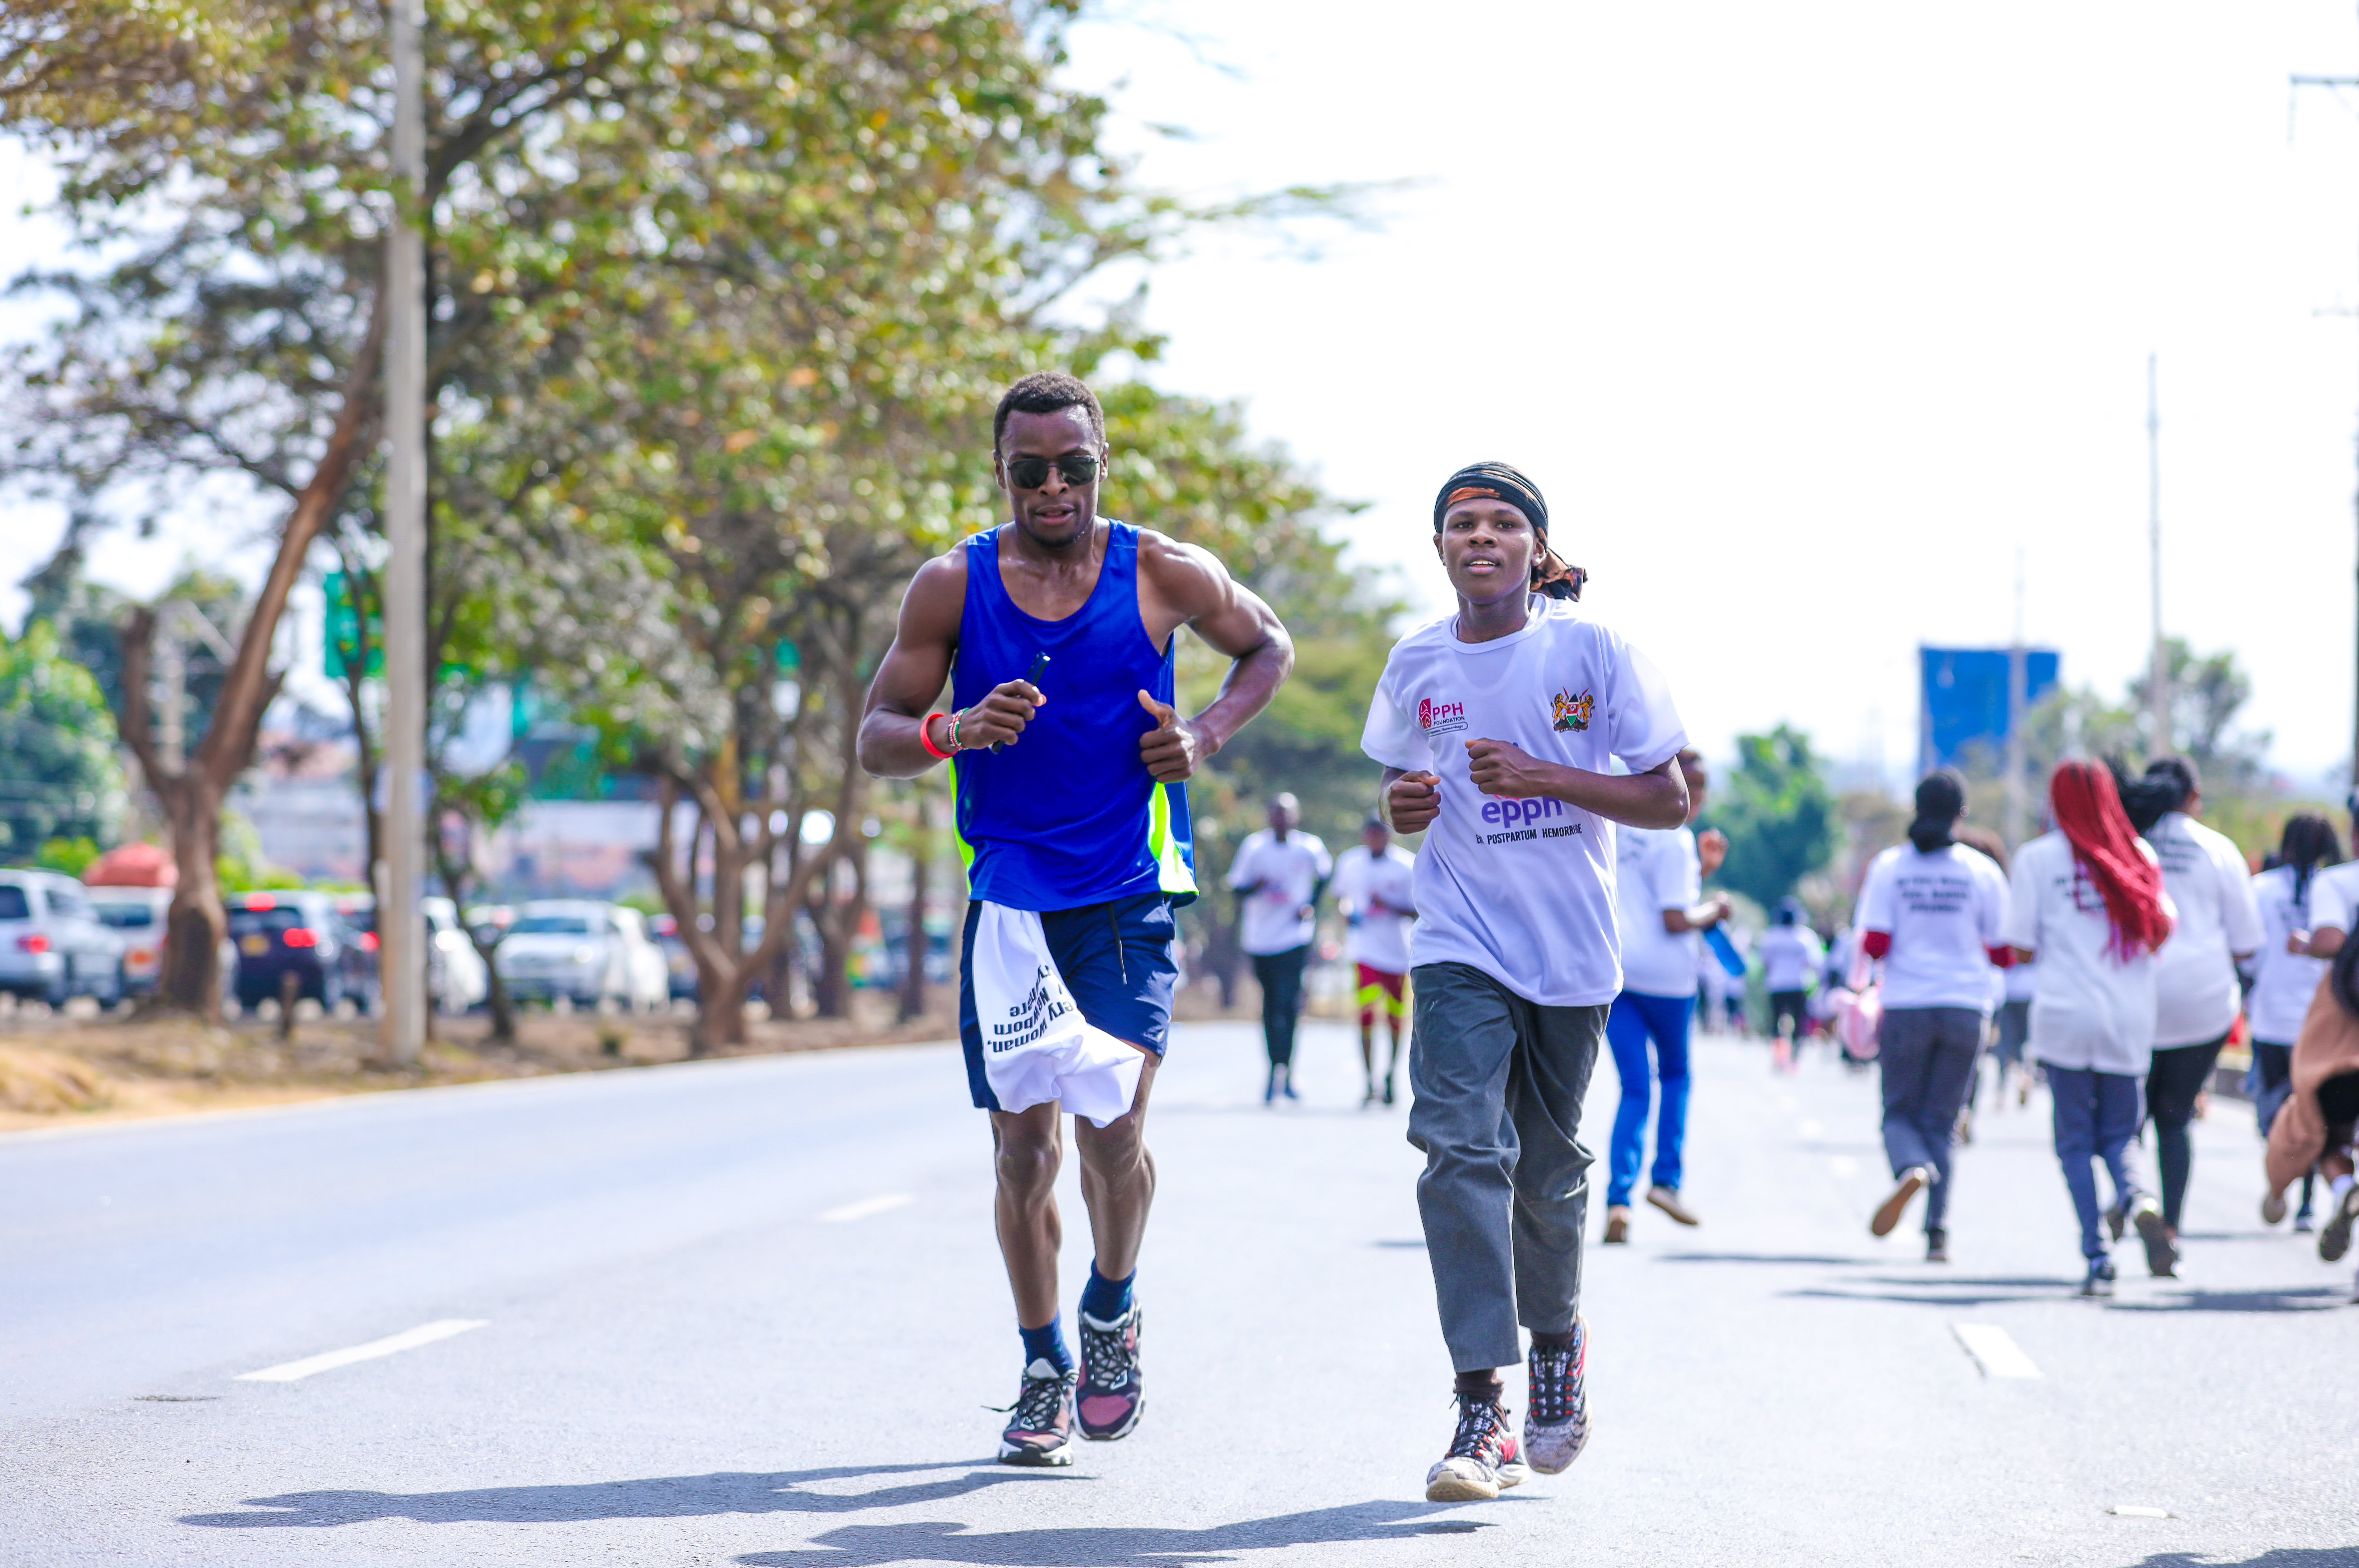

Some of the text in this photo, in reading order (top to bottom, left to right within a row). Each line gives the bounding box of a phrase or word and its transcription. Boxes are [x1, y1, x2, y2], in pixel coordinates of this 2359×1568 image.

[1433, 702, 1463, 720] PPH
[1434, 716, 1465, 726] FOUNDATION
[1487, 829, 1537, 845] POSTPARTUM
